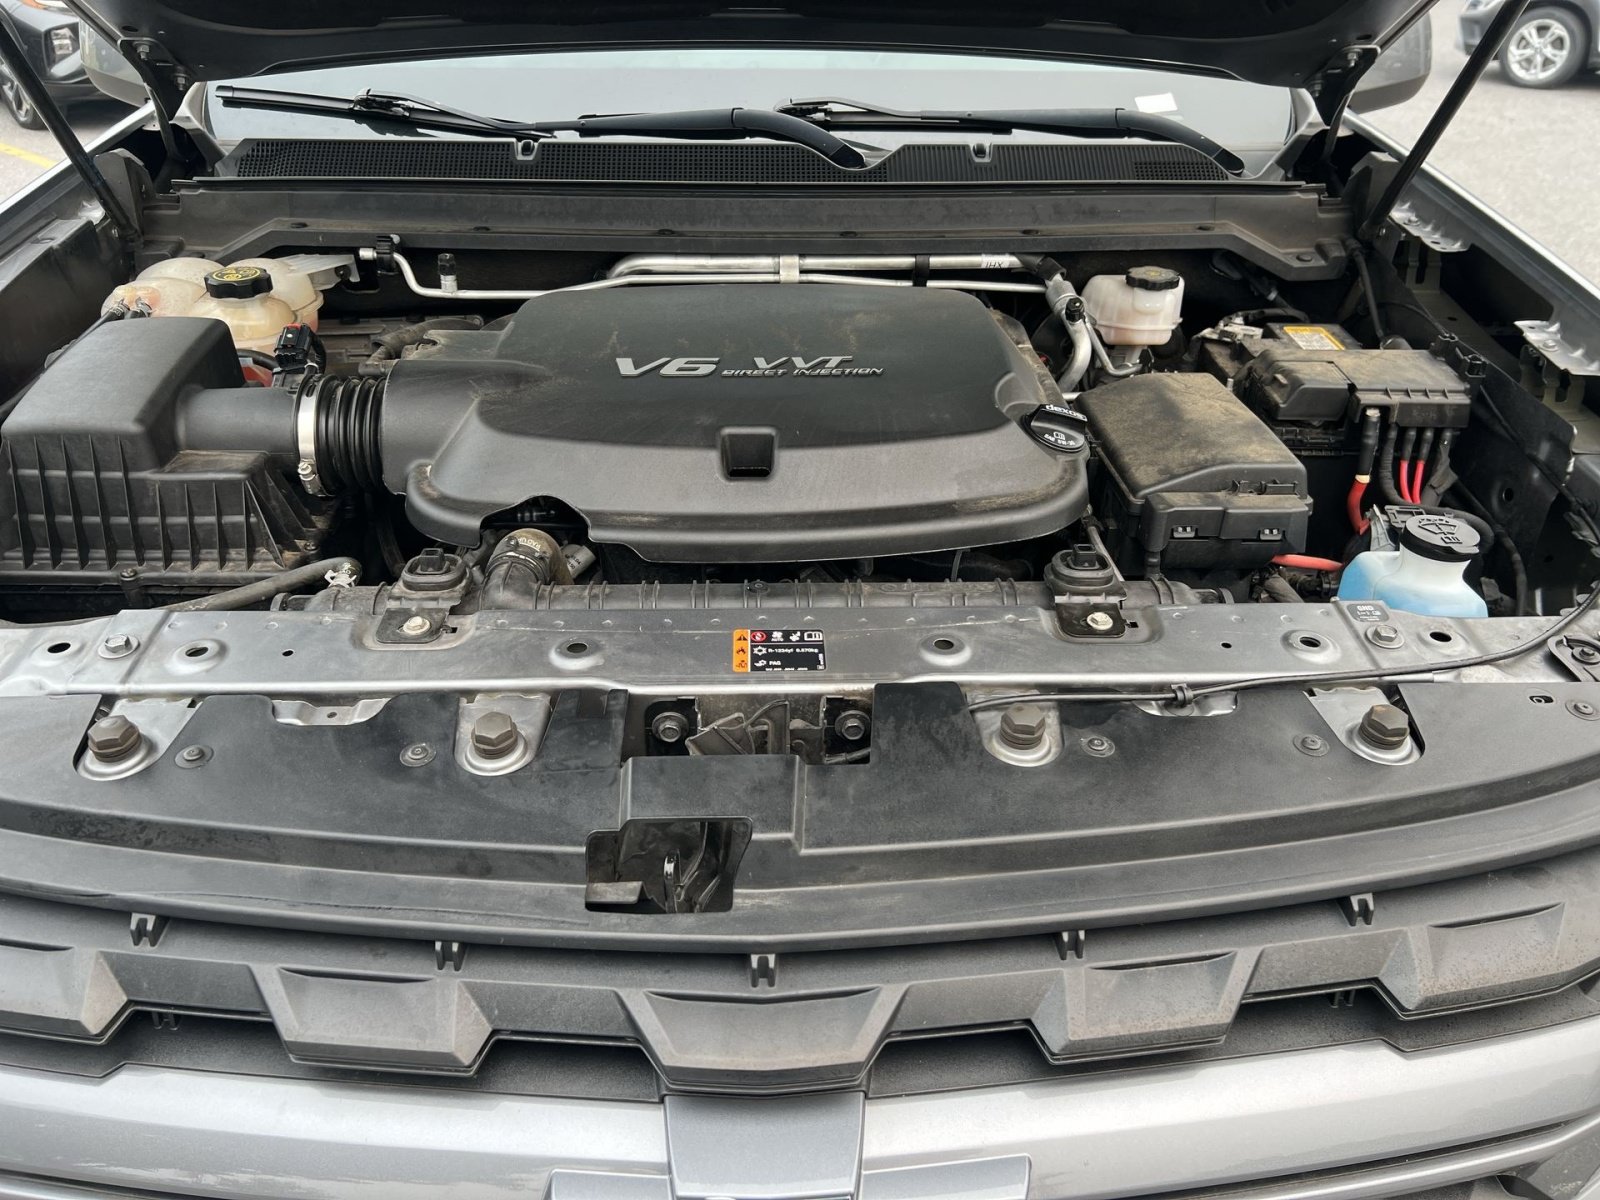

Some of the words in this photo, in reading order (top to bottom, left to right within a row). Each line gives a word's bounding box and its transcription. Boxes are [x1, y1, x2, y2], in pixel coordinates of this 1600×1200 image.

[615, 357, 720, 377] V6
[753, 355, 853, 369] VVT
[721, 368, 787, 377] DIRECT
[793, 367, 884, 377] INJECTION
